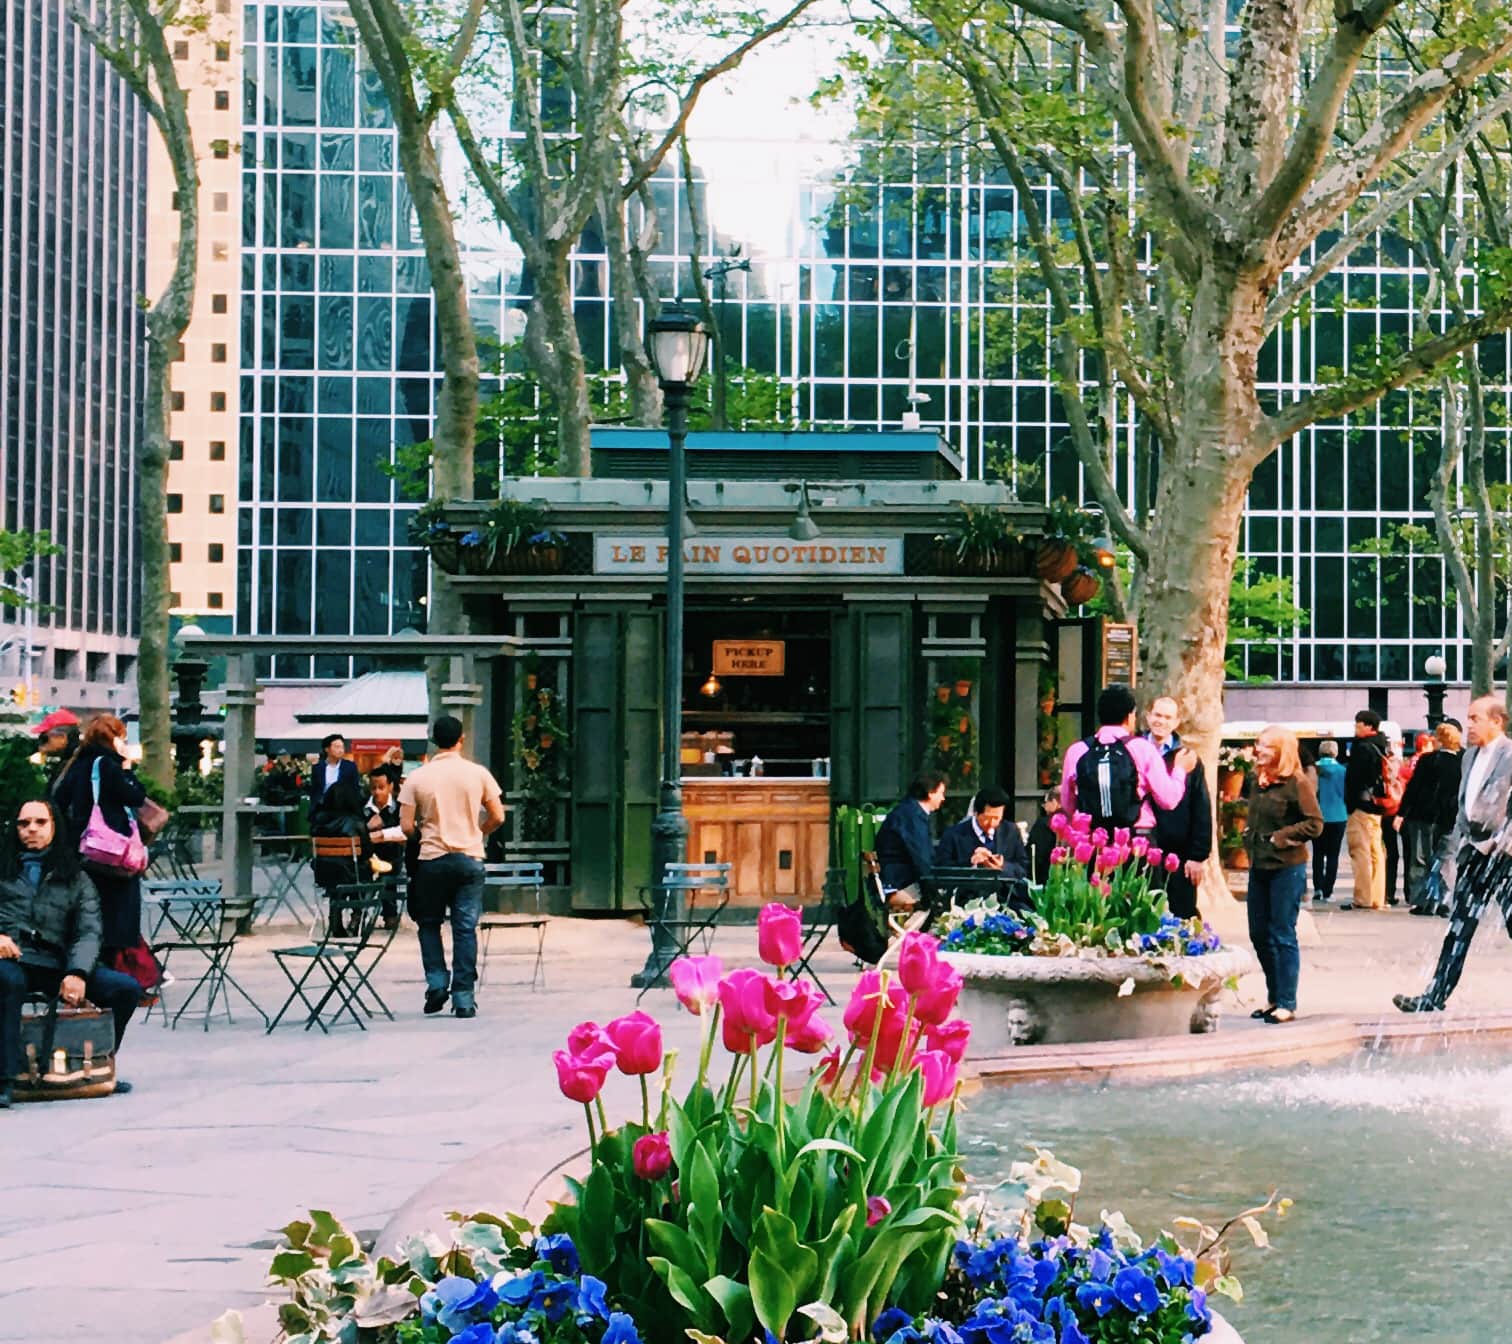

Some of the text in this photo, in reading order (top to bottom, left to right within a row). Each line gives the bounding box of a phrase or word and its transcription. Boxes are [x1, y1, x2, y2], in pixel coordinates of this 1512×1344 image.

[611, 545, 887, 564] LE PIN QUOTIDIEN
[724, 647, 774, 657] PICKUP
[731, 659, 767, 669] HERE
